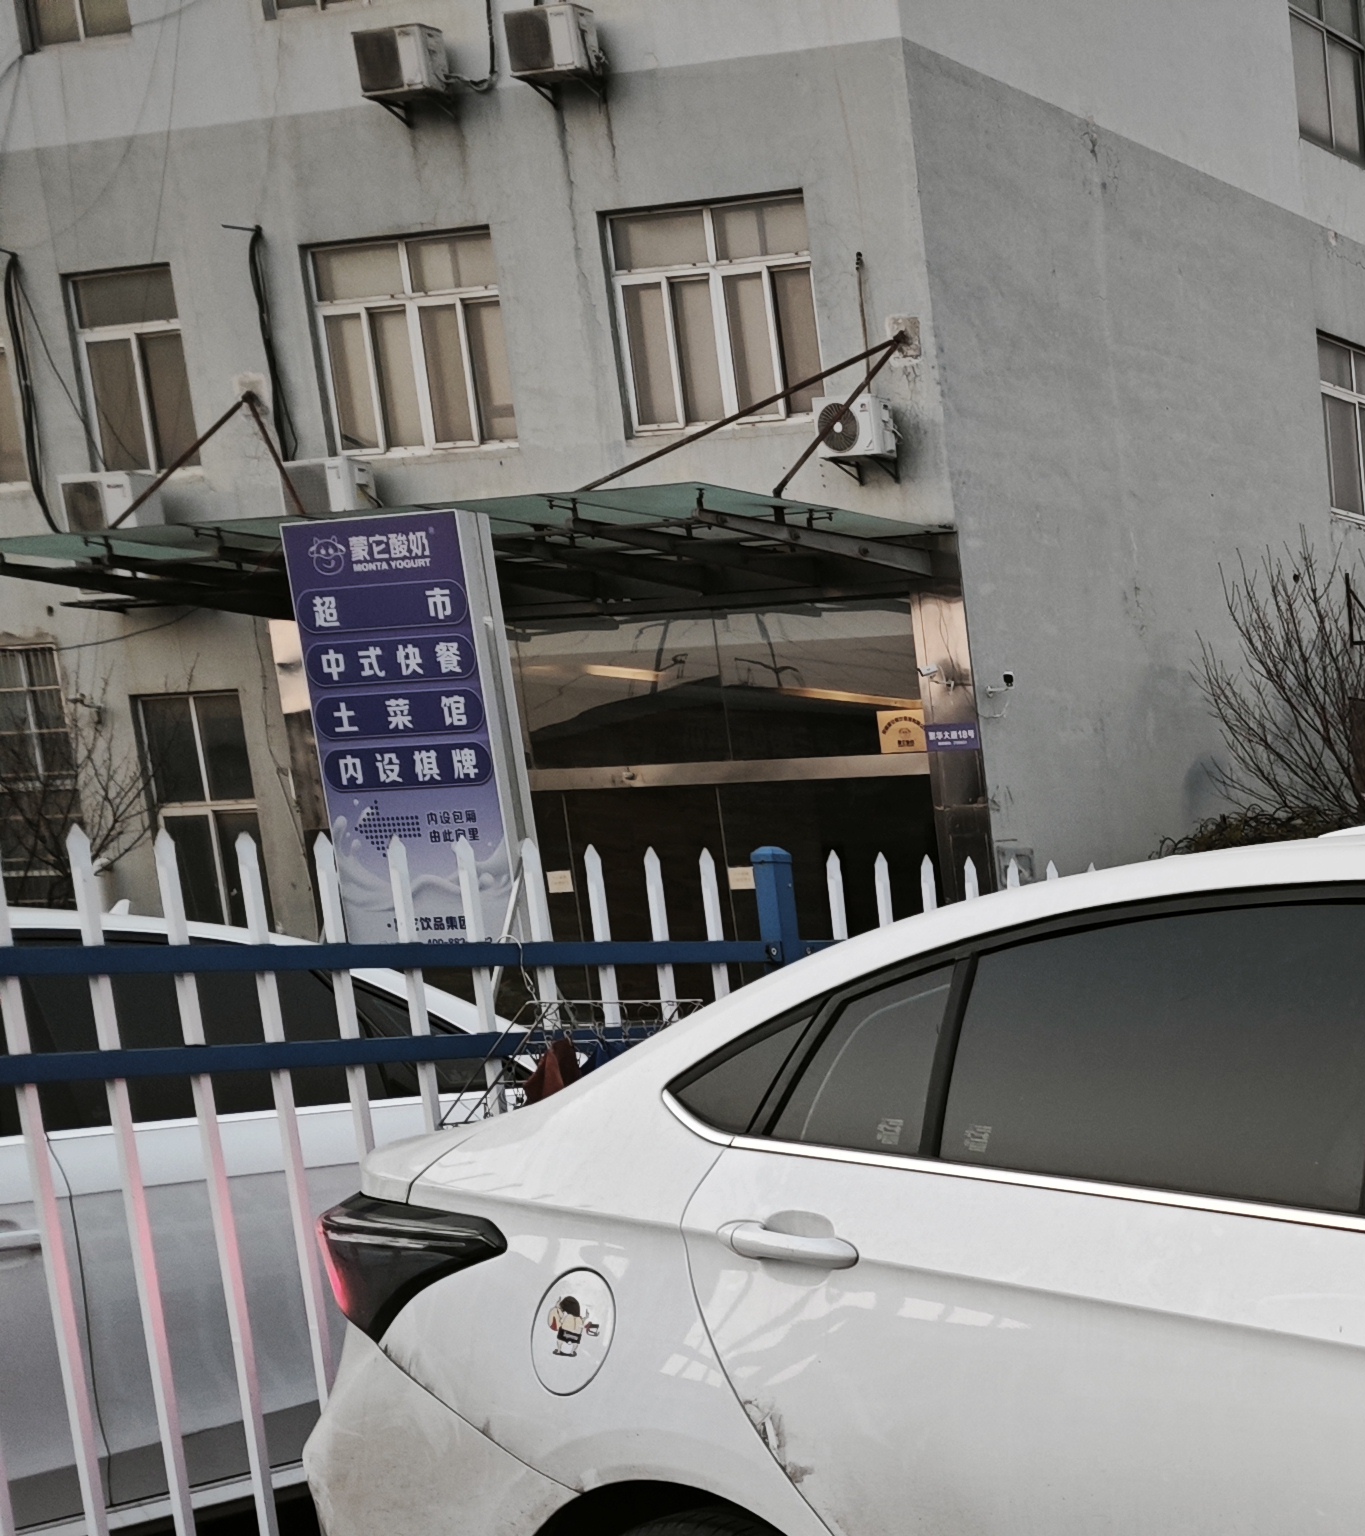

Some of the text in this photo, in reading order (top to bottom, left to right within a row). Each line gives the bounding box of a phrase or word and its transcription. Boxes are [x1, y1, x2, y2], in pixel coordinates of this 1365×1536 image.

[348, 531, 430, 561] 蒙它酸奶
[353, 558, 431, 572] MONTA YOGURT
[312, 587, 453, 628] 超市
[320, 642, 462, 681] 中式快餐
[333, 695, 468, 732] 土菜馆
[338, 748, 479, 786] 内设棋牌
[426, 809, 477, 825] 内设包厢
[429, 827, 480, 843] 由此向里
[394, 915, 467, 932] 饮品集团
